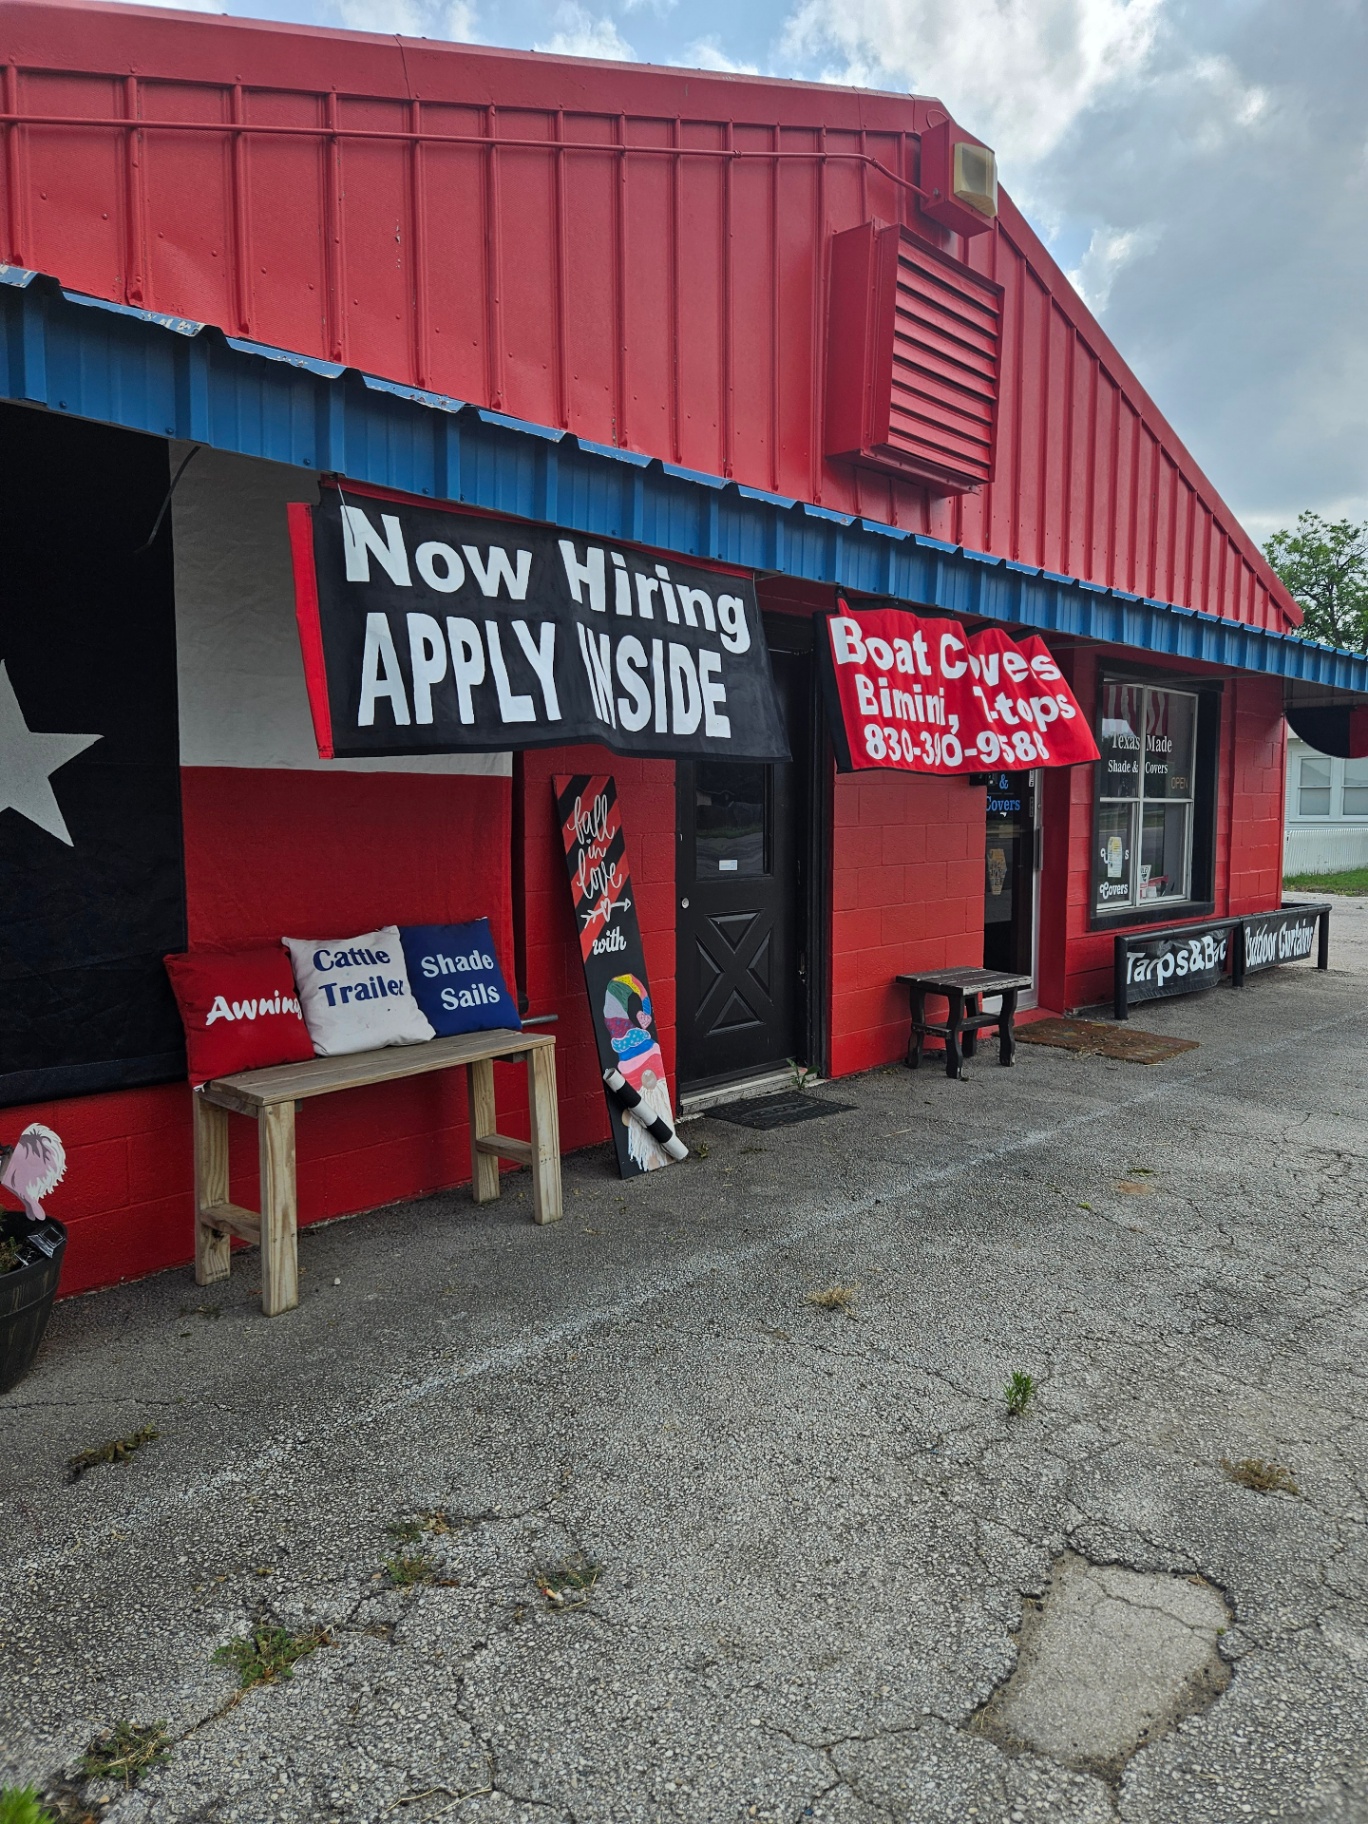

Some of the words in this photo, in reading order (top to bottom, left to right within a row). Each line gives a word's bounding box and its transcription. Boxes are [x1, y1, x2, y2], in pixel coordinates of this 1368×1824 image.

[340, 505, 532, 600] Now
[558, 540, 751, 655] Hiring
[829, 617, 932, 676] Boat
[357, 612, 562, 727] APPLY
[576, 621, 732, 739] INSIDE
[854, 673, 960, 735] Bimini,
[1112, 733, 1140, 751] Texas
[1146, 735, 1173, 753] Made
[1107, 759, 1131, 773] Shade
[1132, 760, 1139, 773] &
[1145, 761, 1168, 774] Covers
[999, 773, 1009, 790] &
[986, 795, 1021, 812] Covers
[567, 794, 615, 845] fall
[586, 838, 607, 860] in
[576, 848, 623, 900] love
[1099, 881, 1129, 900] Covers
[592, 926, 627, 956] with
[1245, 923, 1278, 968] Outdoor
[313, 947, 391, 972] Cattle
[421, 950, 495, 979] Shade
[440, 982, 501, 1011] Sails
